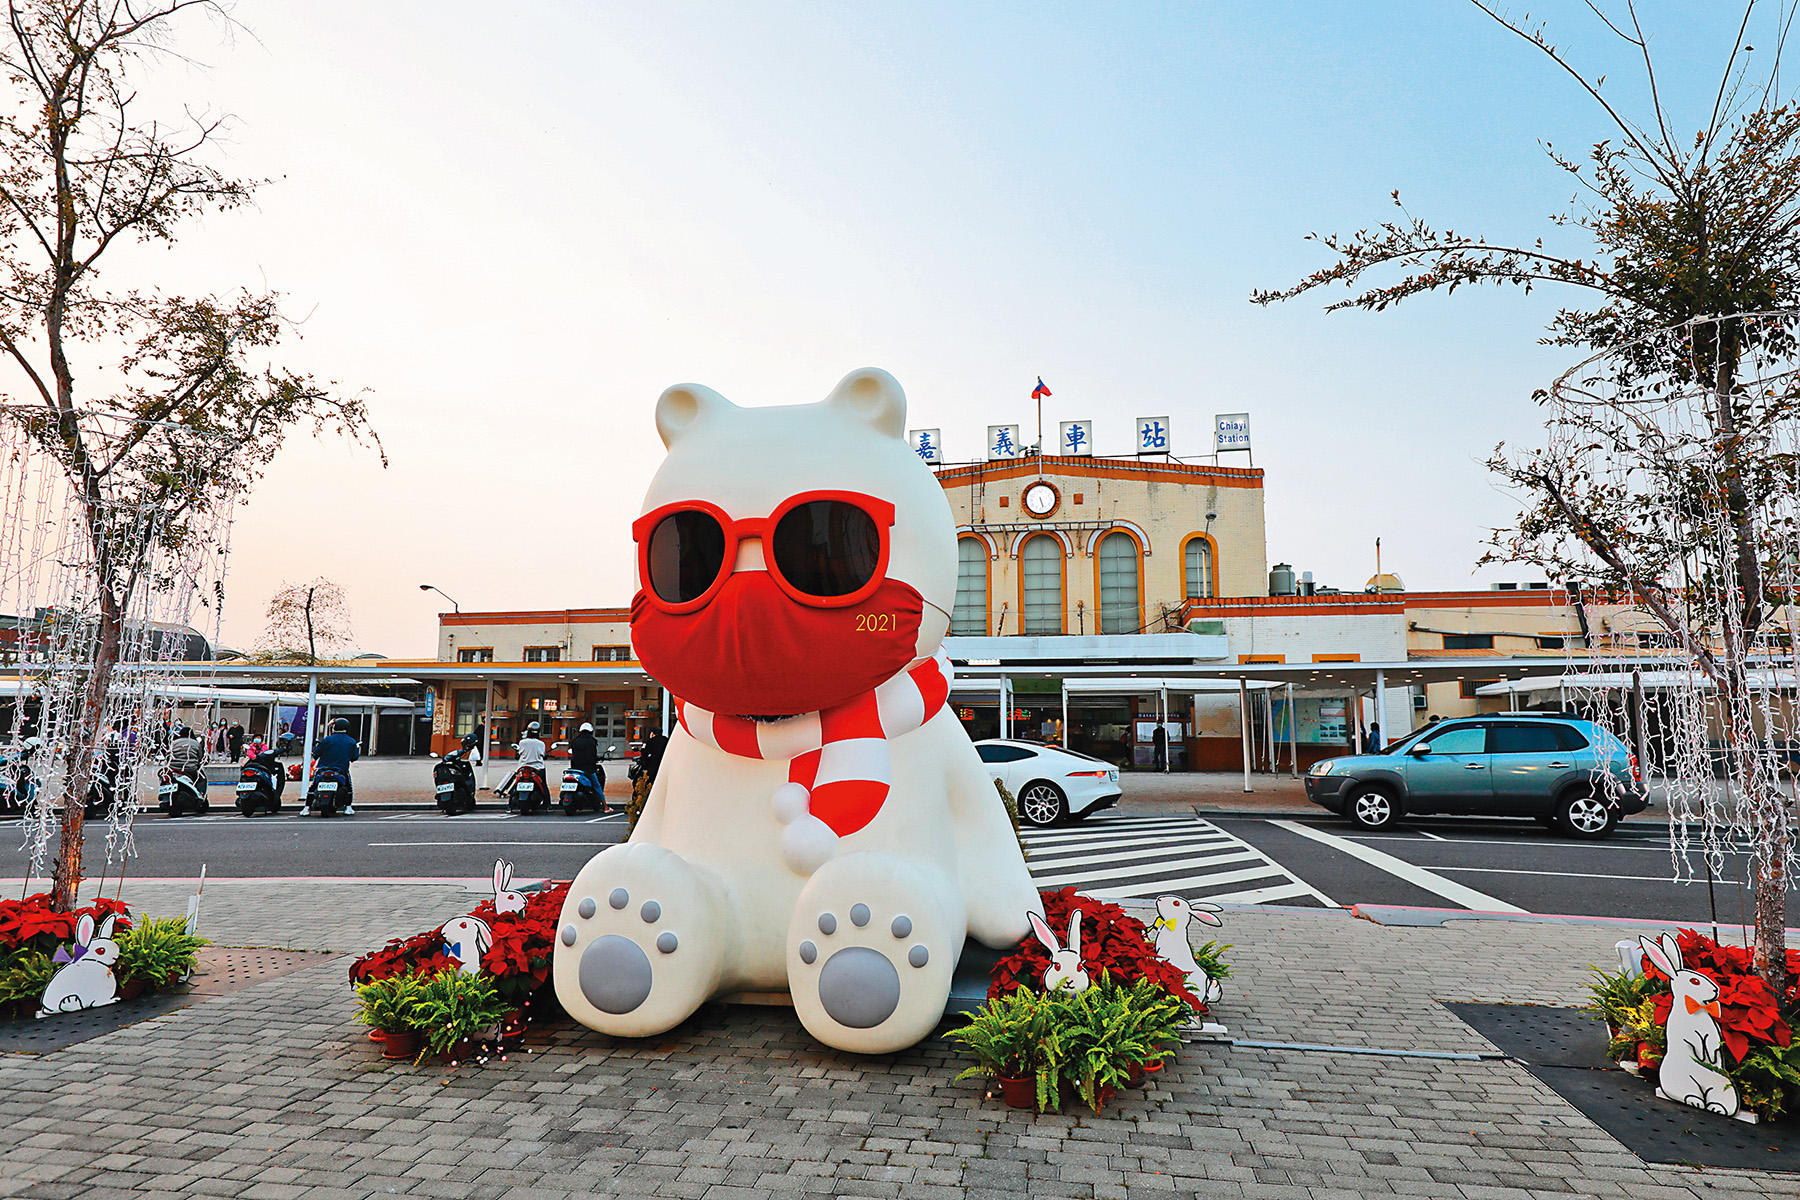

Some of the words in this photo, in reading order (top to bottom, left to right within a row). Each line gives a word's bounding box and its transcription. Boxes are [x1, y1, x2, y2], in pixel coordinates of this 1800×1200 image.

[1219, 420, 1246, 431] Chiayi
[915, 421, 1166, 459] 嘉義車站
[1218, 433, 1249, 443] Station
[856, 613, 896, 632] 2021
